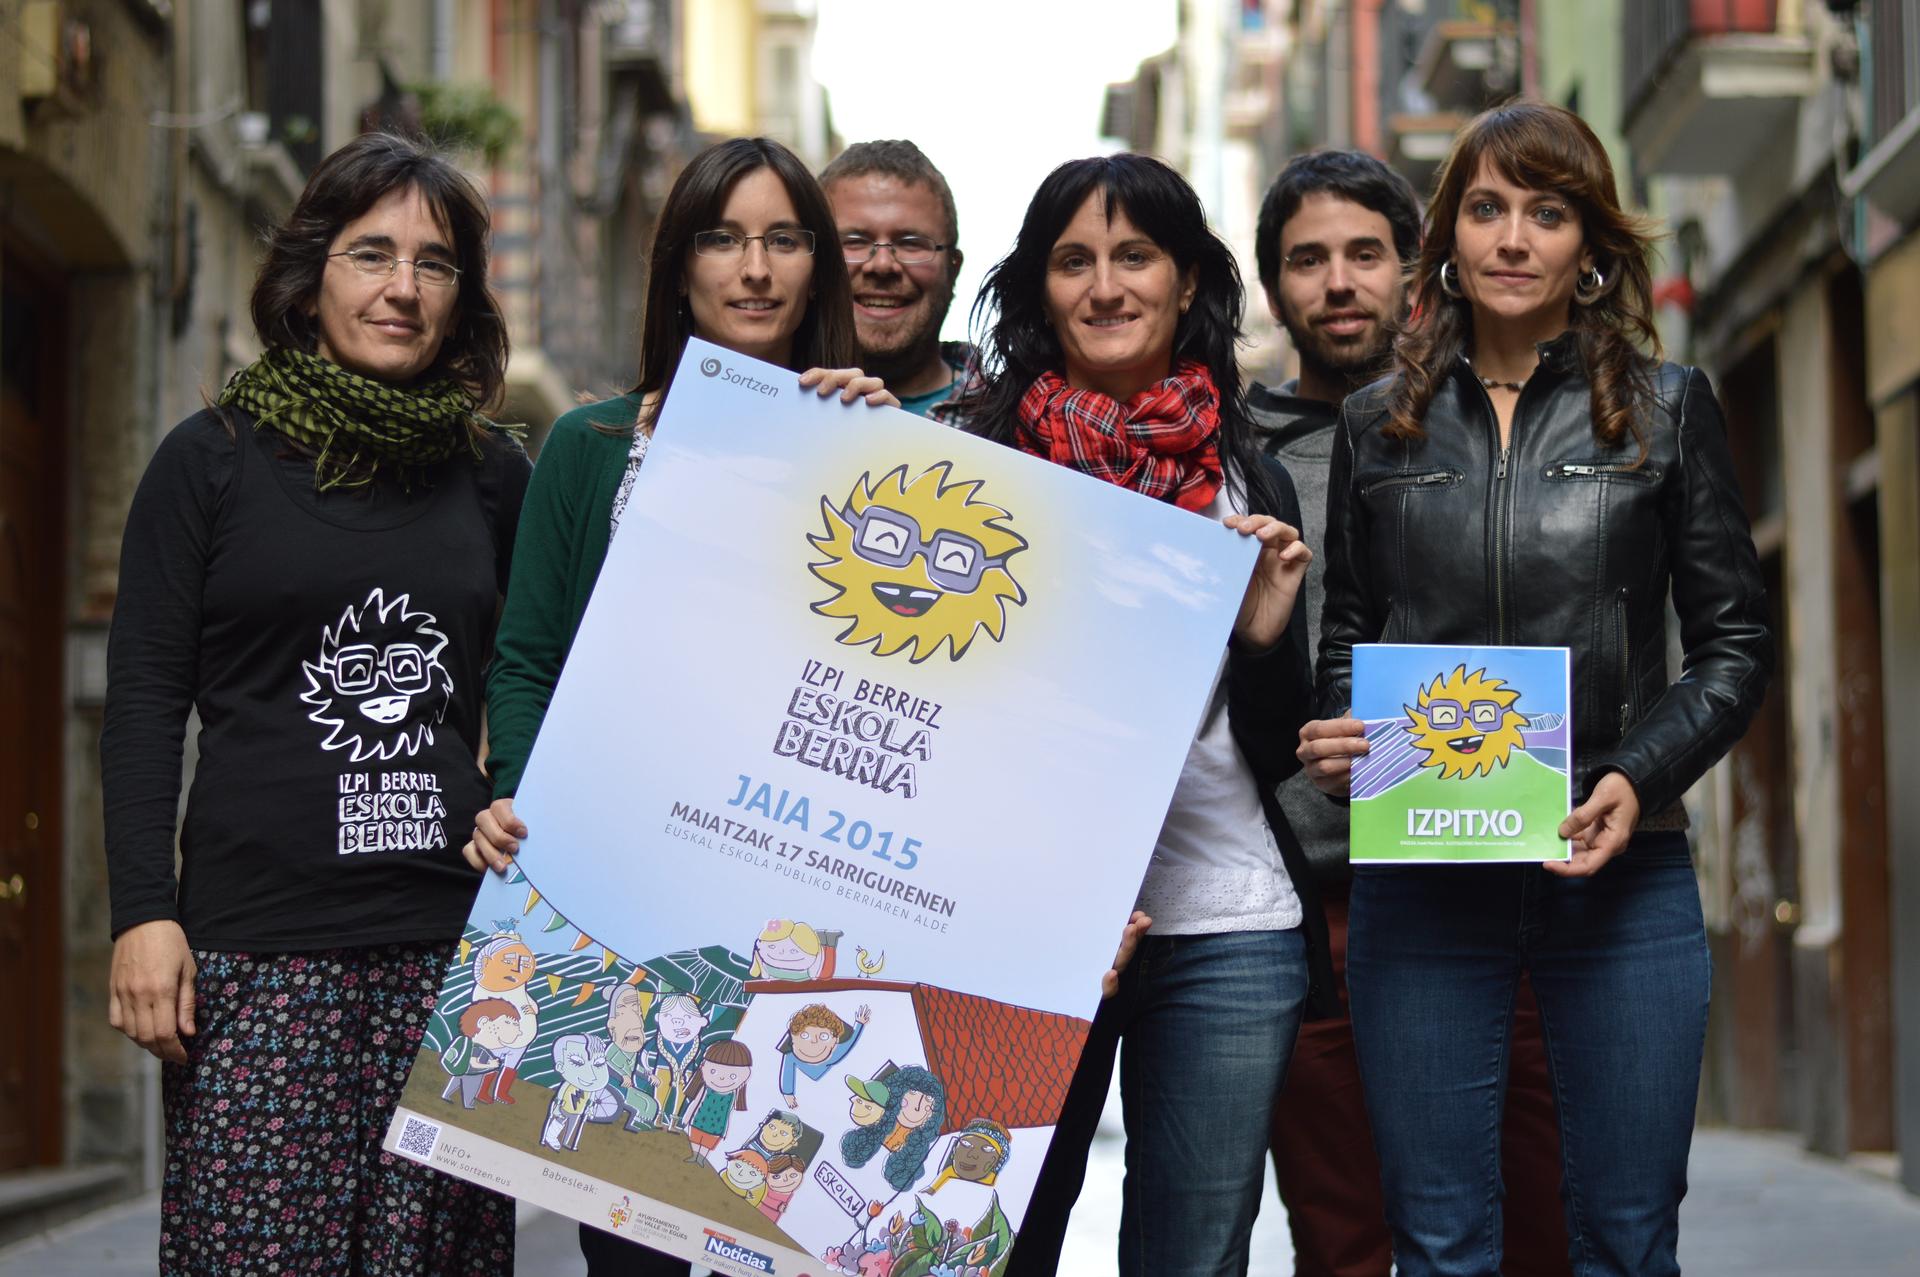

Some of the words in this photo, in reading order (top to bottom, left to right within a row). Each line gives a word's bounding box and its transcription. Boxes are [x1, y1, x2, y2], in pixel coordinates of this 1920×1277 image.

[721, 368, 779, 398] Sortzen
[801, 659, 844, 692] IZPI
[854, 679, 942, 730] BERRIEZ
[787, 686, 931, 761] ESKOLA
[773, 720, 917, 798] BERRIA
[339, 773, 369, 793] IZPI
[381, 772, 442, 792] BERRIEZ
[339, 793, 447, 822] ESKOLA
[727, 774, 810, 832] JAIA
[820, 810, 922, 870] 2015
[1407, 808, 1523, 837] IZPITXO
[338, 820, 448, 854] BERRIA
[670, 801, 774, 851] MAIATZAK
[776, 842, 803, 861] 17
[805, 850, 956, 917] SARRIGURENEN
[664, 823, 713, 850] EUSKAL
[719, 843, 769, 869] ESKOLA
[775, 863, 831, 891] PUBLIKO
[836, 885, 909, 920] BERRIAREN
[914, 914, 949, 934] ALDE
[440, 1143, 471, 1159] INFO+
[436, 1155, 512, 1187] www.sortzen.eus
[542, 1167, 599, 1195] Babesleak:
[817, 1166, 853, 1209] ESKOLA
[707, 1237, 767, 1270] Noticias
